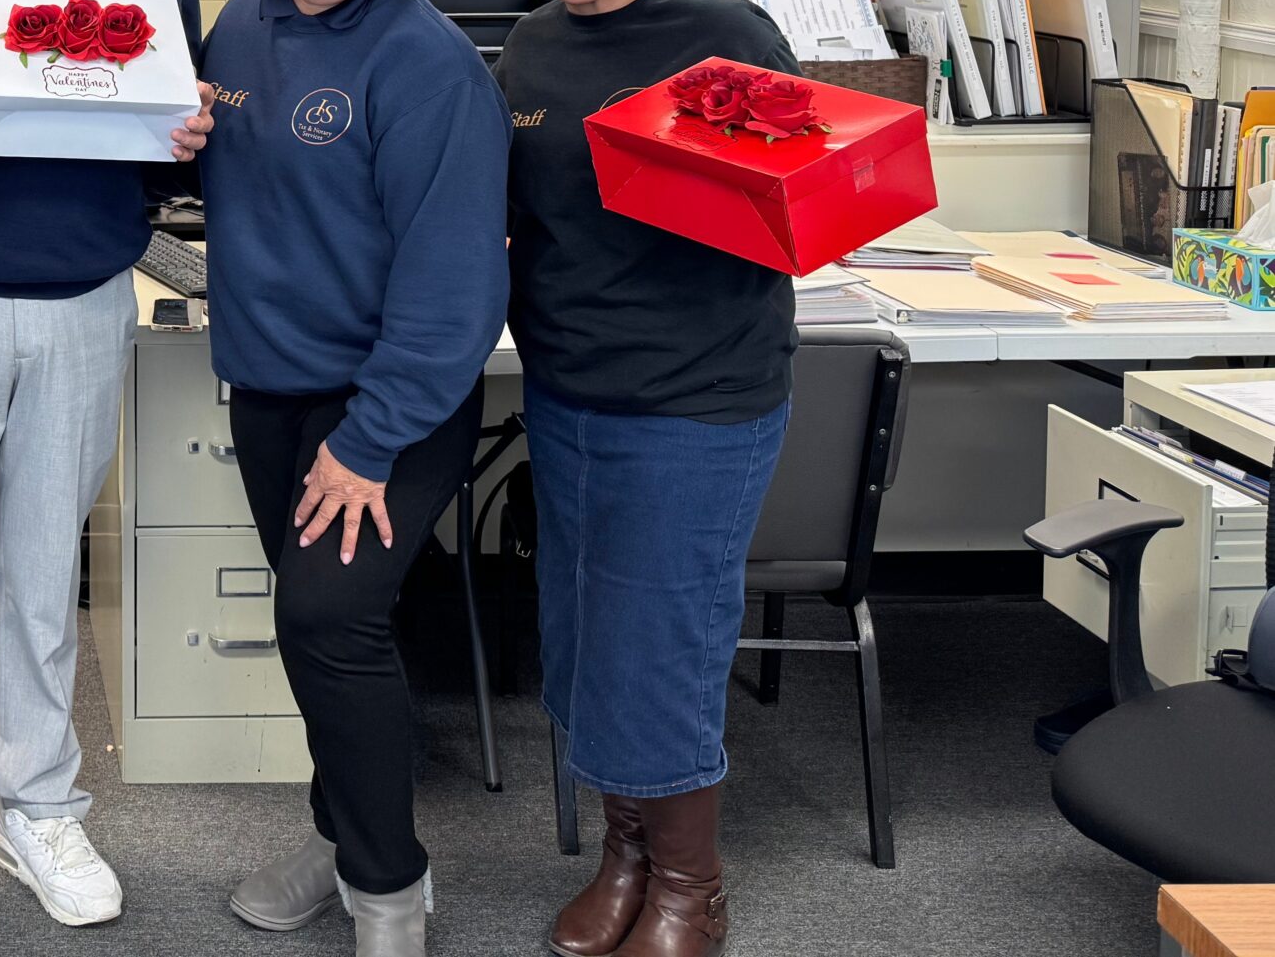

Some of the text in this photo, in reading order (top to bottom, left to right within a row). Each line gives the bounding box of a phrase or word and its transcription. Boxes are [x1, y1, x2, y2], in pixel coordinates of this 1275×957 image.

[1021, 22, 1032, 60] MANAGEMENT
[46, 73, 111, 89] Valentines
[302, 131, 323, 141] Services
[313, 127, 333, 138] Notary
